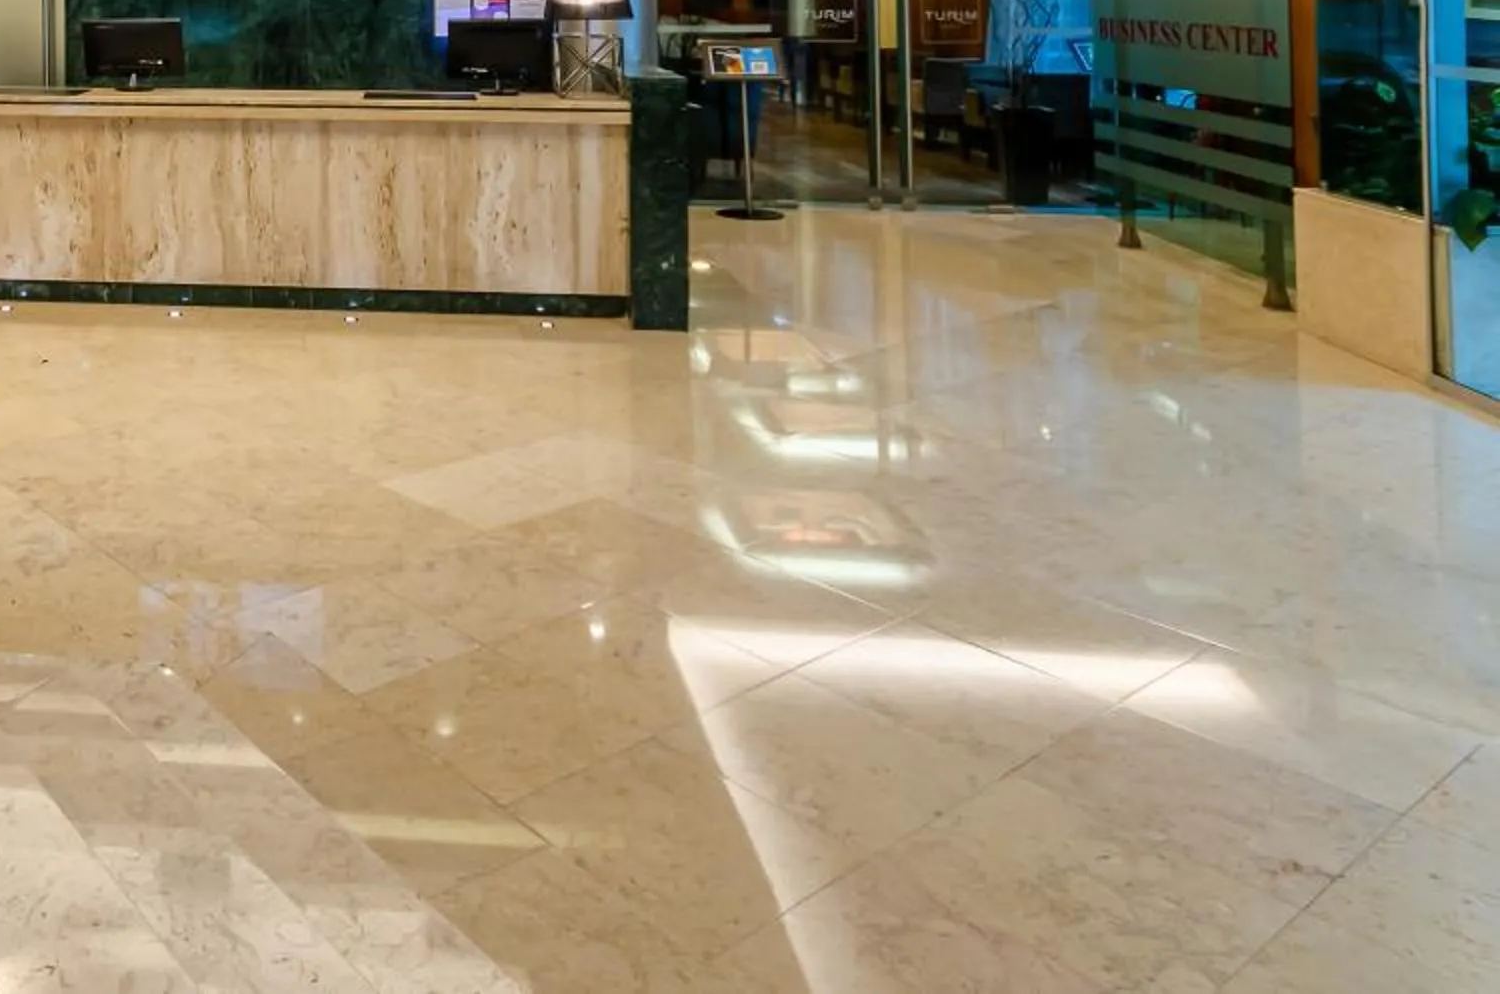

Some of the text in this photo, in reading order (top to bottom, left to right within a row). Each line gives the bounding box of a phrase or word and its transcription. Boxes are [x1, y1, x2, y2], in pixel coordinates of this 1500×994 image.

[924, 10, 978, 24] TURIM
[1099, 17, 1279, 59] BUSINESS CENTER
